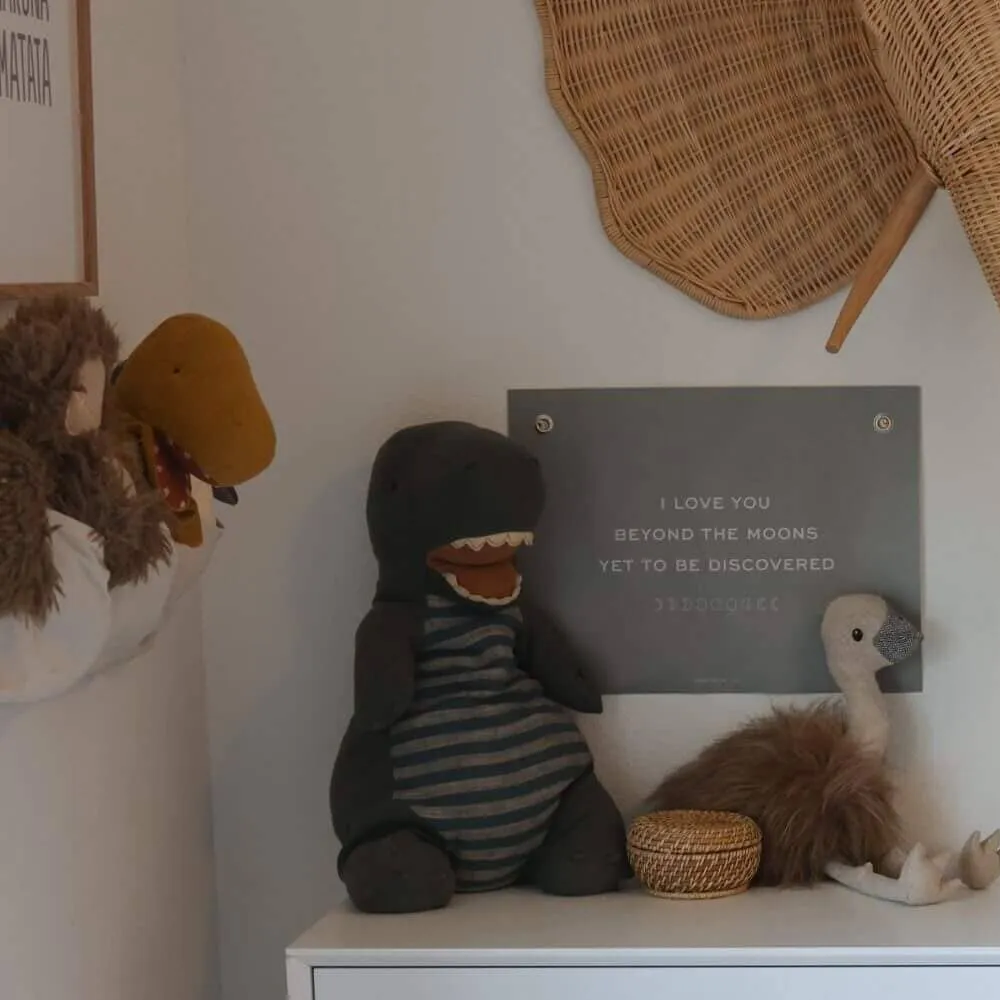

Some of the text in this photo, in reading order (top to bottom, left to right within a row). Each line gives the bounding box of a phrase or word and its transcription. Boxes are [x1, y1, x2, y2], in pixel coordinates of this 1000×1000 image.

[660, 496, 771, 510] I LOVE YOU
[614, 527, 818, 542] BEYOND THE MOONS
[599, 558, 835, 573] YET TO BE DISCOVERED
